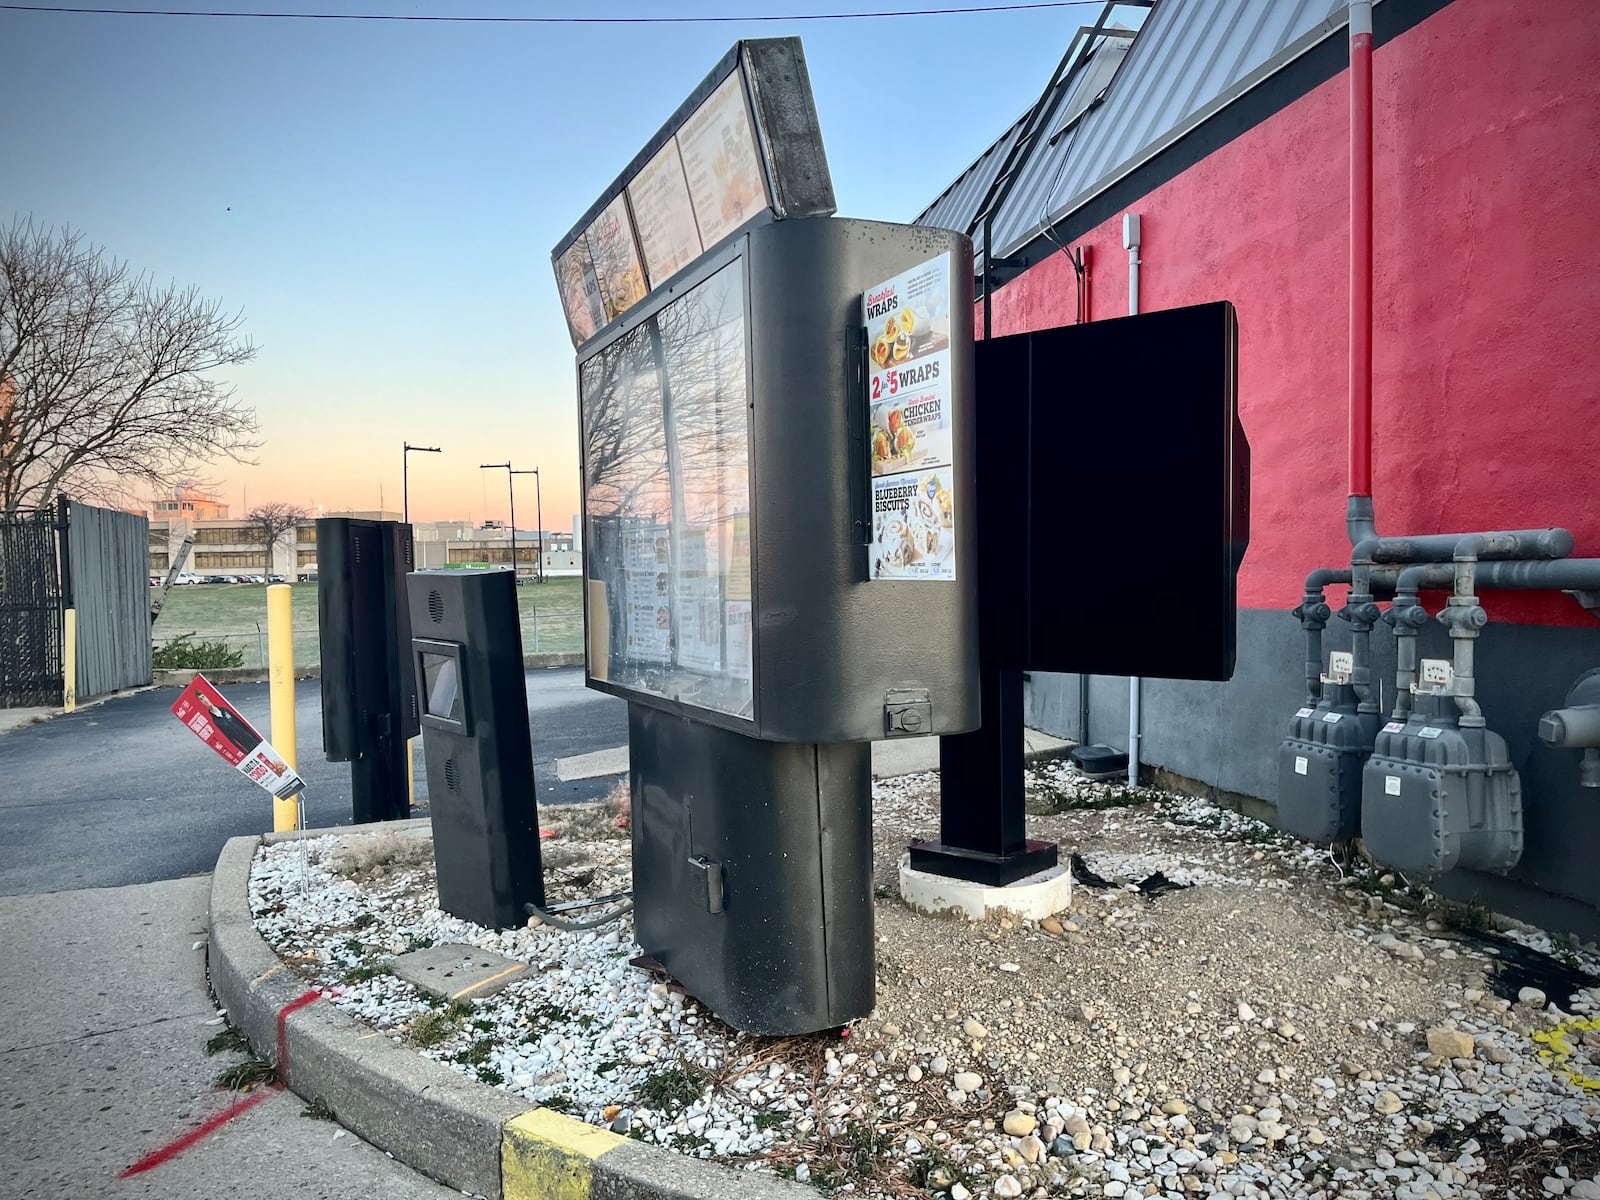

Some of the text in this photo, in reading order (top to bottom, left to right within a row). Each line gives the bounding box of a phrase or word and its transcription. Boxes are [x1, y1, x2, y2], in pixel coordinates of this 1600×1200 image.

[867, 295, 898, 320] WRAPS
[872, 376, 881, 399] 2
[899, 361, 939, 388] WRAPS
[903, 399, 941, 419] CHICKEN
[904, 412, 941, 427] TENDER WRAPS
[875, 484, 919, 501] BLUEBERRY
[875, 498, 910, 512] BISCUITS
